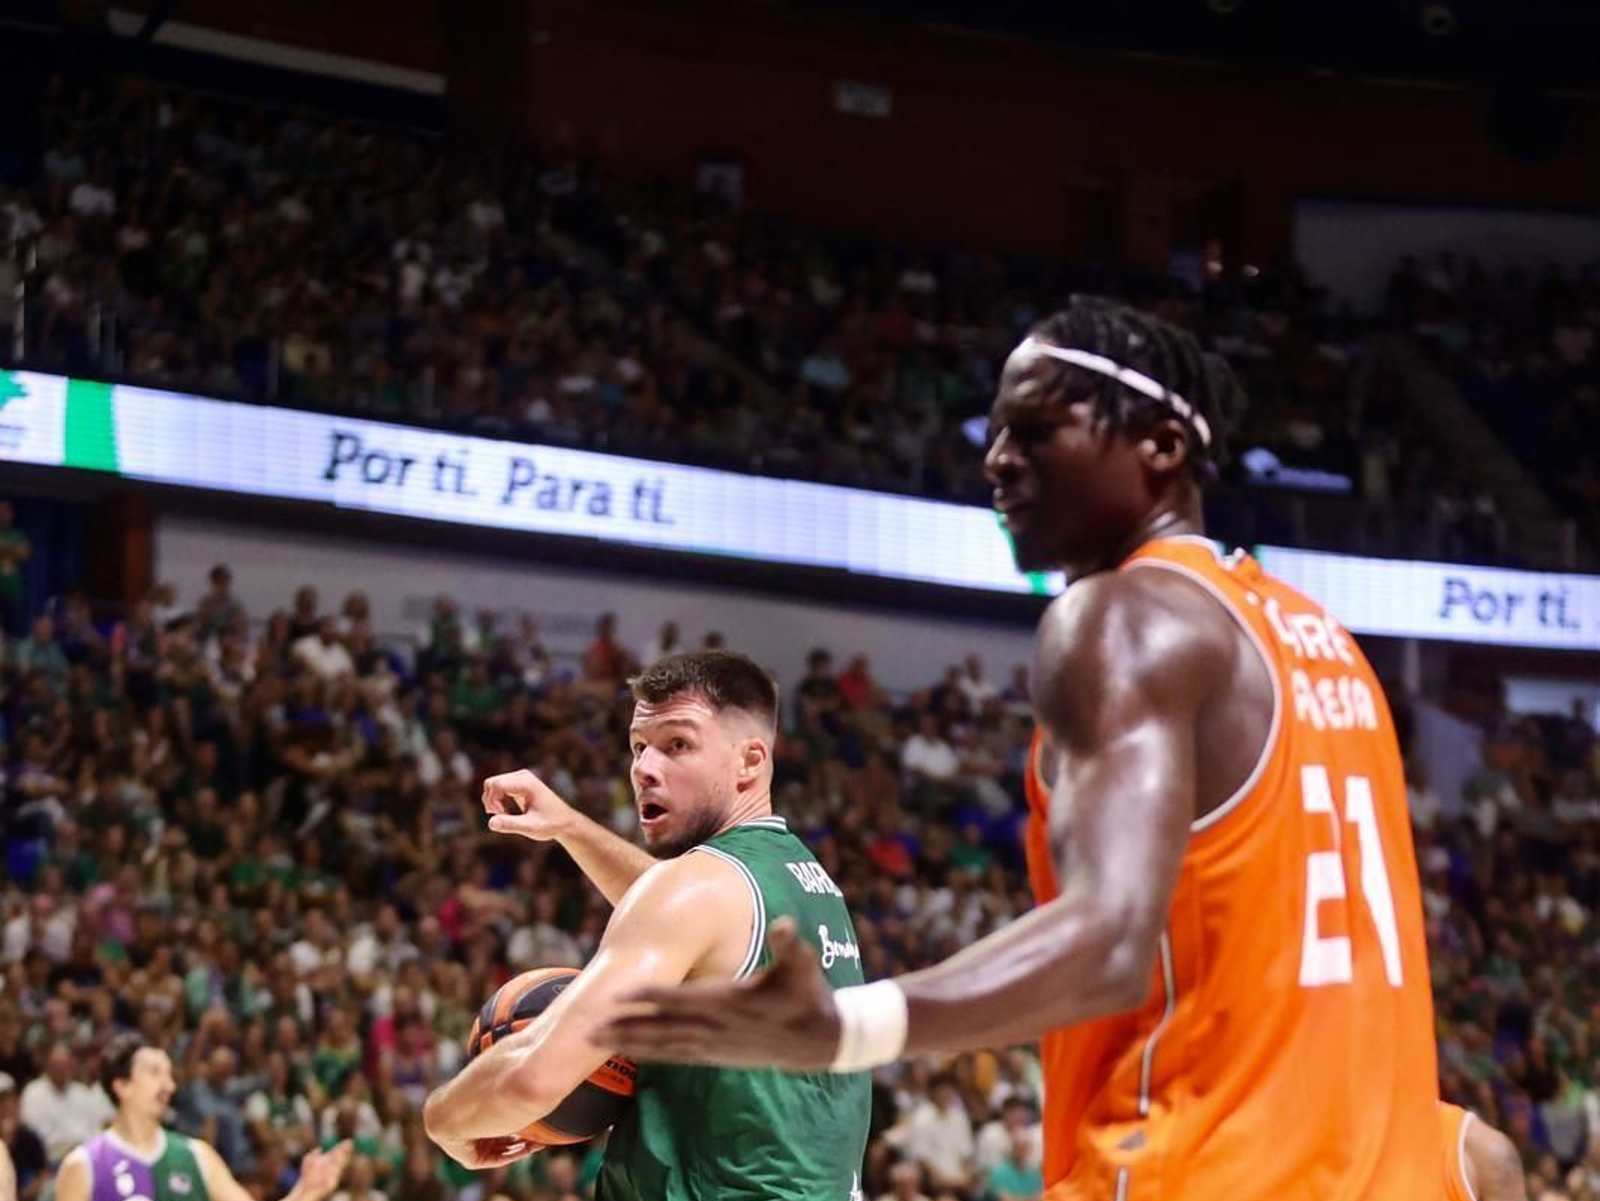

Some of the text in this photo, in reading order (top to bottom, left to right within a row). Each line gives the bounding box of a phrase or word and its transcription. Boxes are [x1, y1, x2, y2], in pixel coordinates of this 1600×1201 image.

[323, 430, 414, 486] Por
[501, 457, 612, 517] Para
[1439, 577, 1581, 629] Por ti.
[1298, 763, 1404, 988] 21
